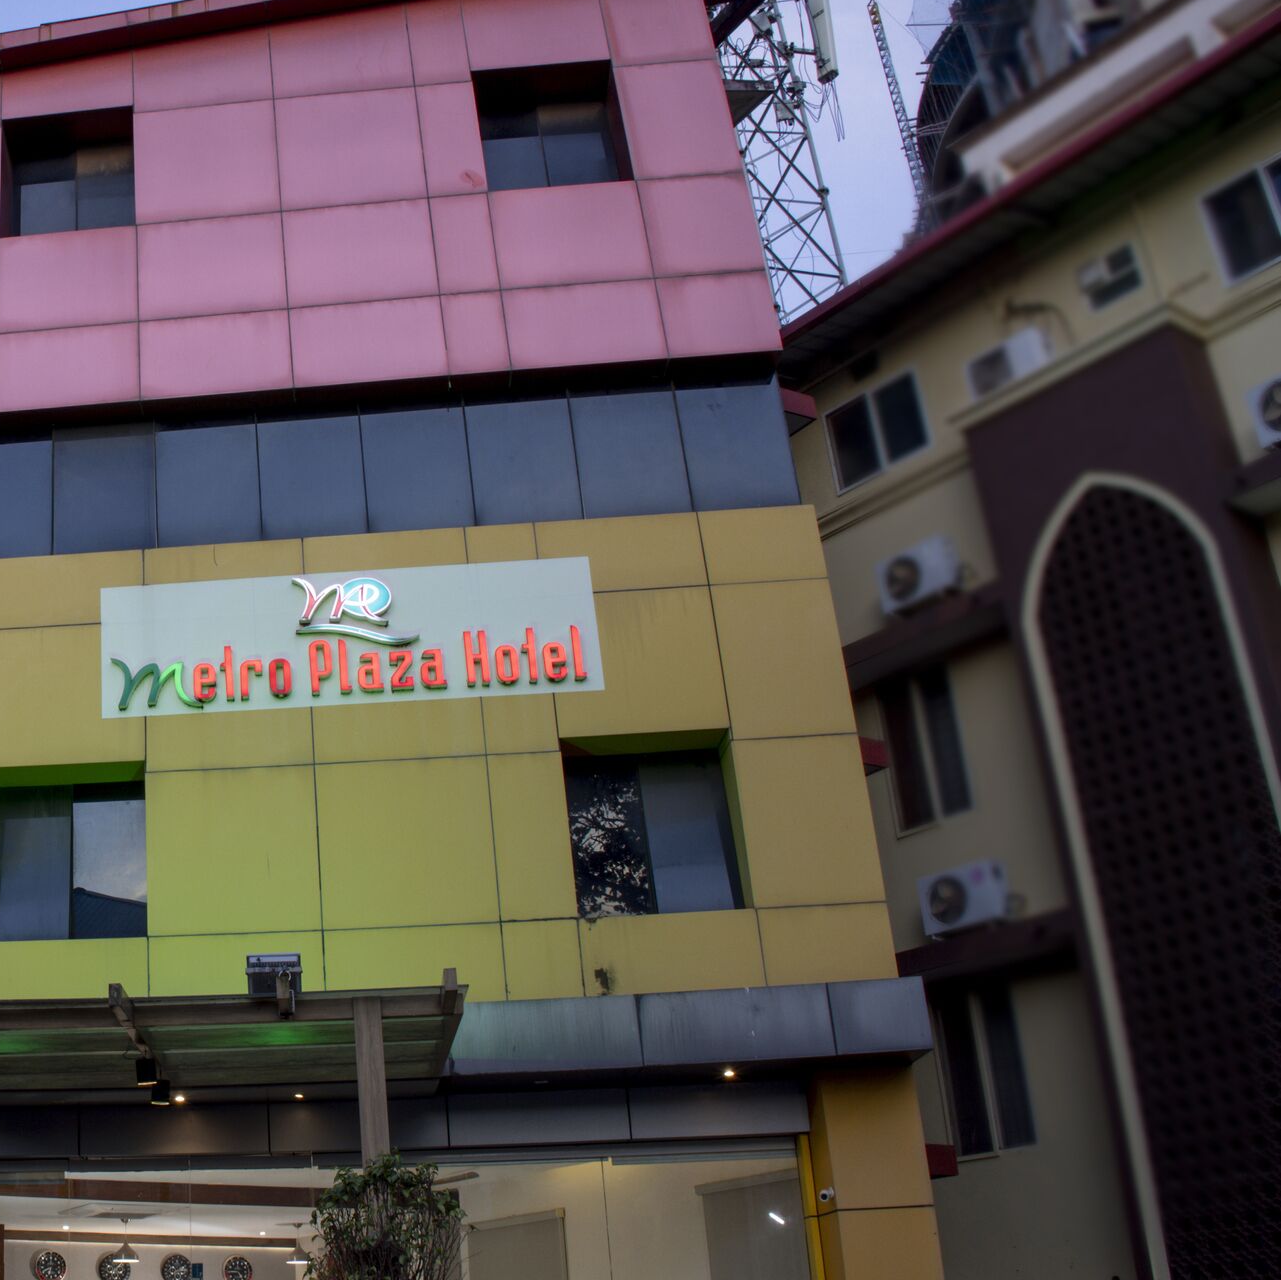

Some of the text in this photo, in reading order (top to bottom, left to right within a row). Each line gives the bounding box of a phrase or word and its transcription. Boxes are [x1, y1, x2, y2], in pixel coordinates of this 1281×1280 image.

[110, 624, 588, 711] Metro Plaza Hotel
